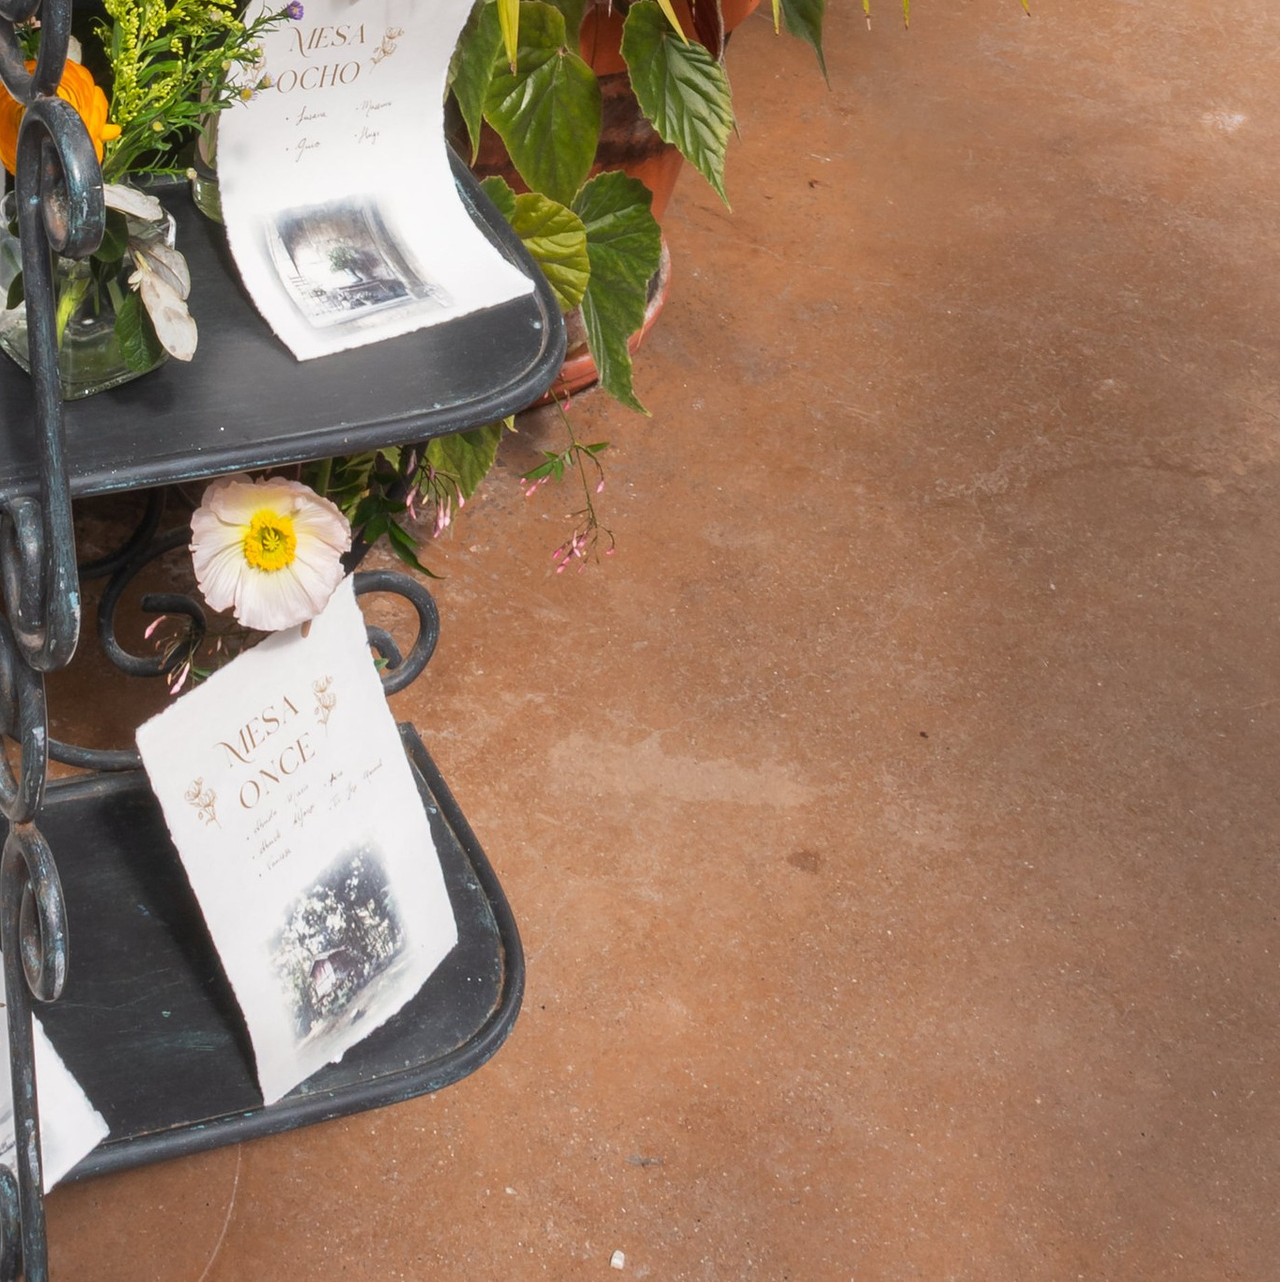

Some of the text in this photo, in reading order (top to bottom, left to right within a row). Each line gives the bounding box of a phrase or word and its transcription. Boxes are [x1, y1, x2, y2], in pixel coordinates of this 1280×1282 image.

[288, 23, 366, 59] MESA
[276, 60, 361, 94] OCHO
[213, 695, 299, 771] MESA
[239, 733, 316, 809] ONCE
